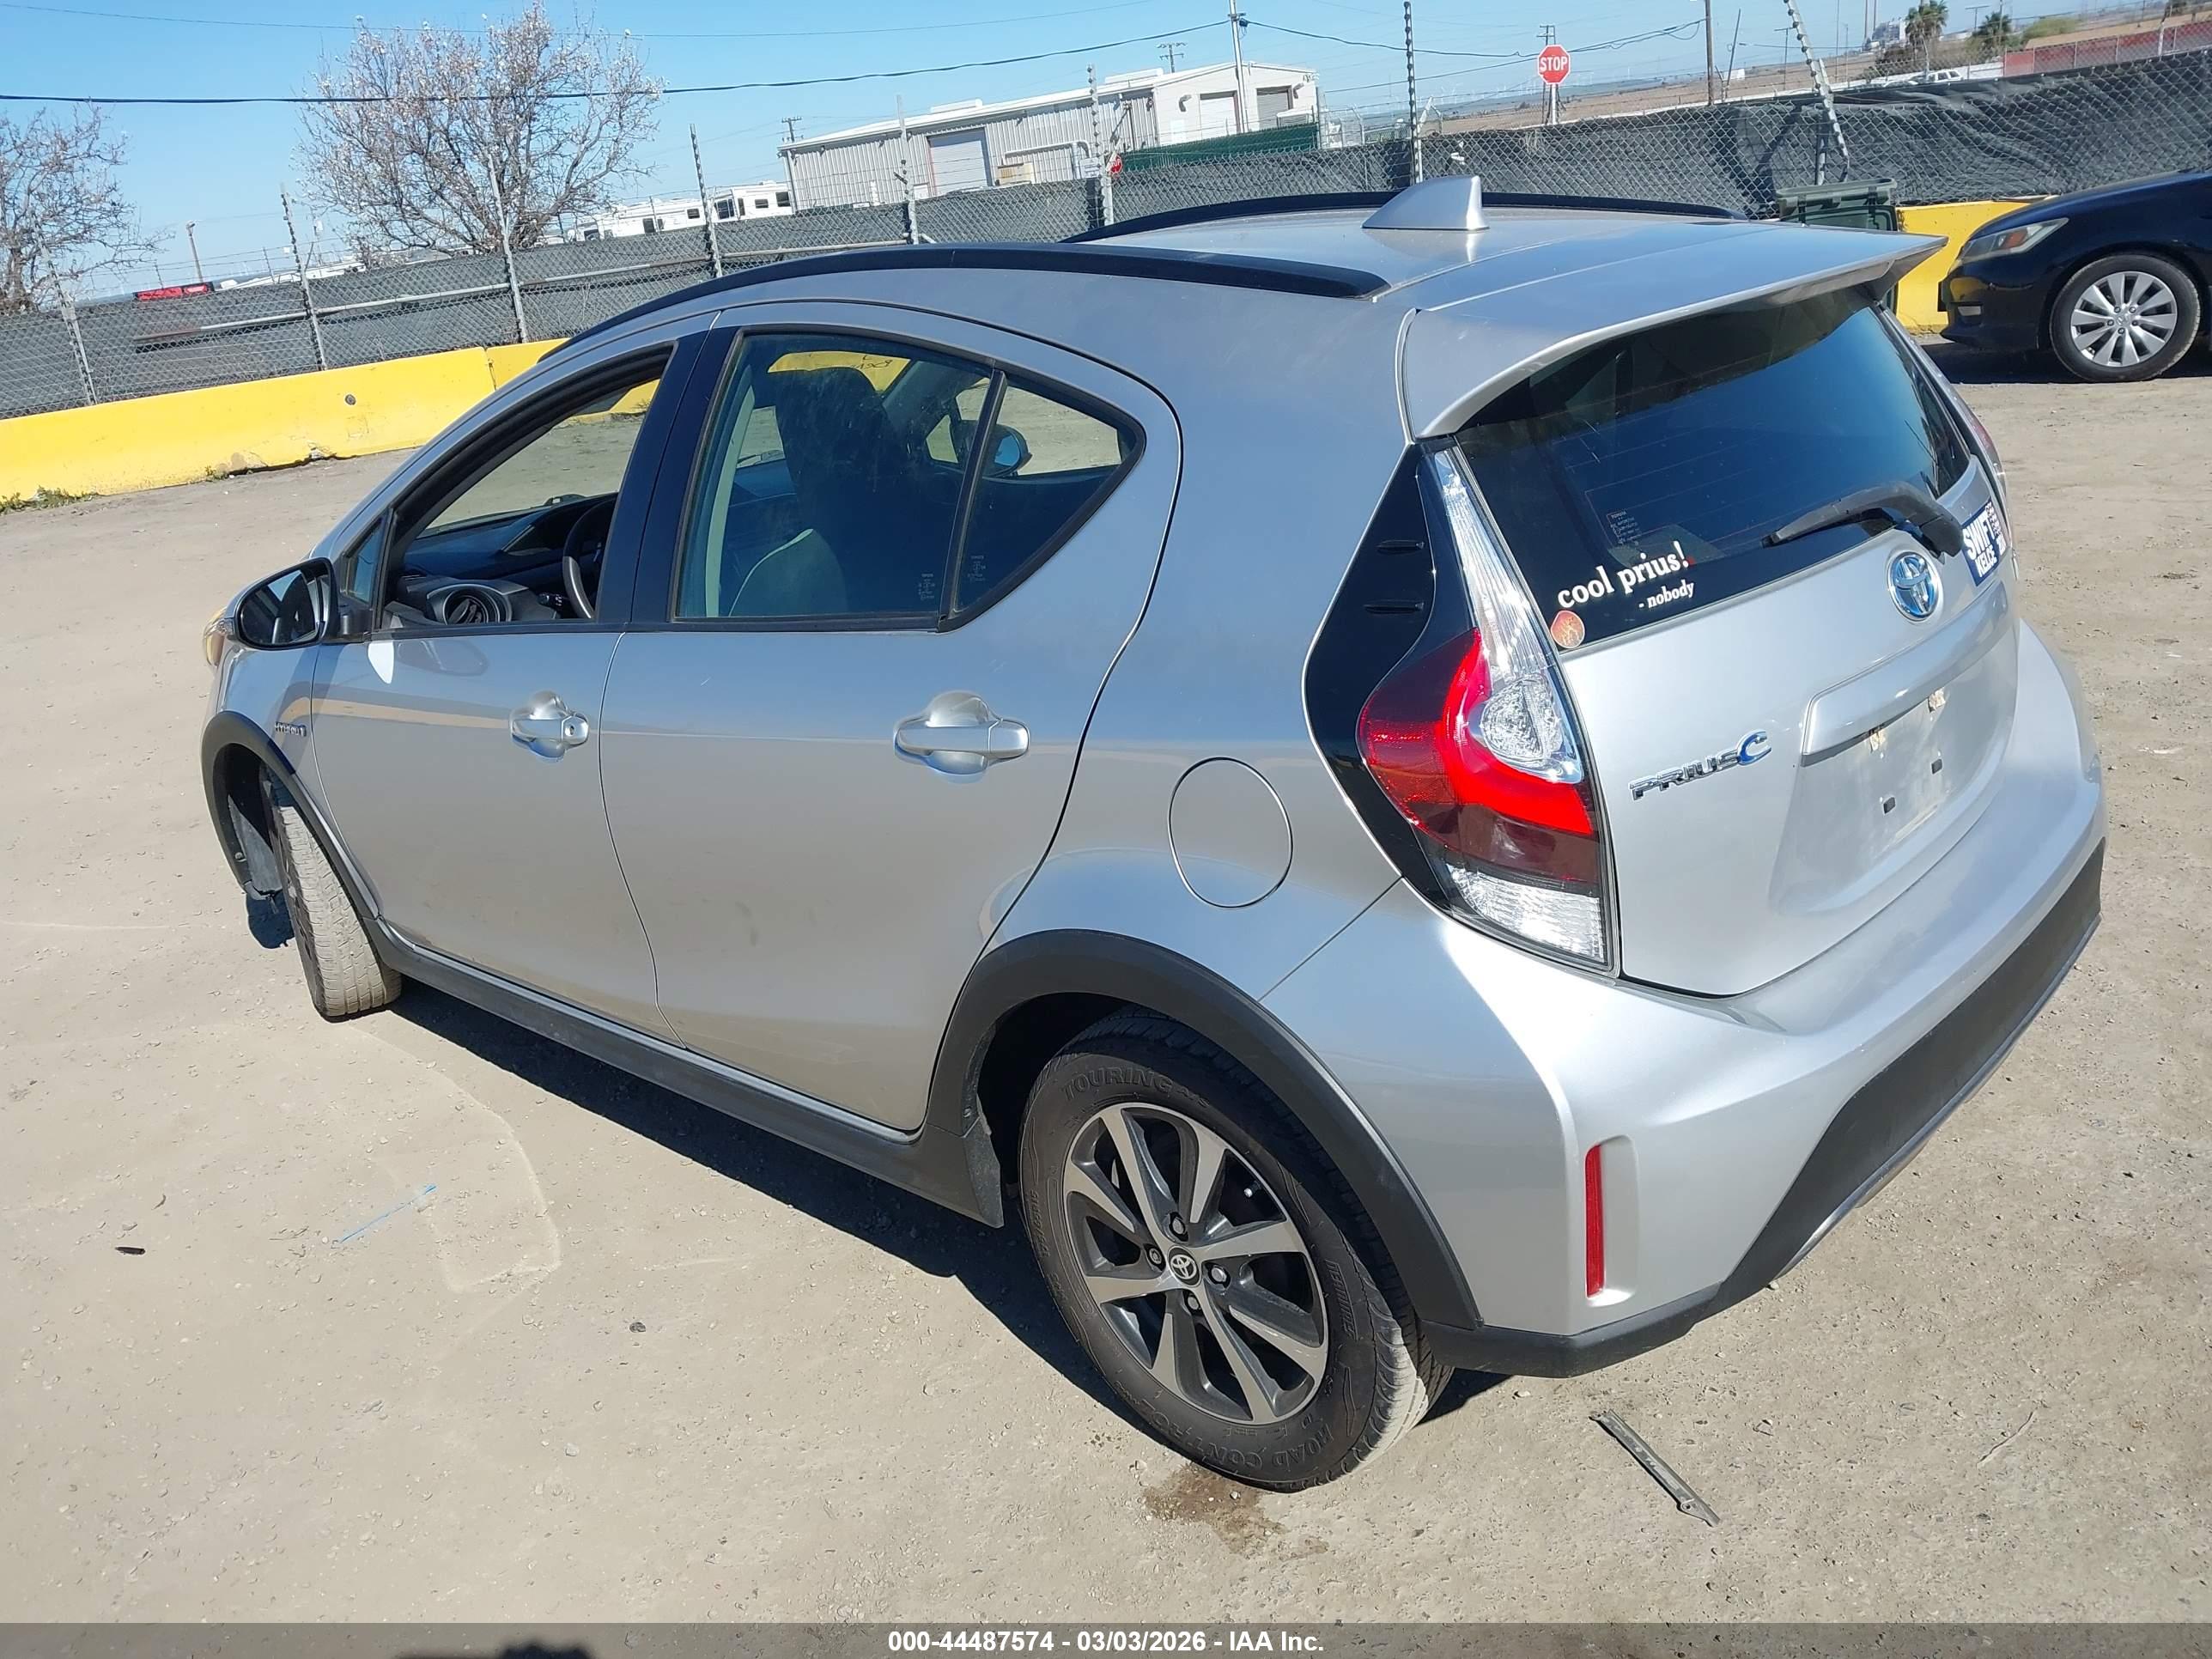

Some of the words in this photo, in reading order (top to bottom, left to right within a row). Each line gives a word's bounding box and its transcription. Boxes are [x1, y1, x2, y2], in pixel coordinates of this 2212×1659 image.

[1540, 56, 1568, 72] STOP
[1962, 509, 1996, 561] SWIFT
[1558, 564, 1615, 608] cool
[1617, 540, 1690, 595] prius!
[1975, 544, 1997, 578] KELCE
[1646, 579, 1695, 609] nobody
[1060, 1066, 1174, 1103] TOURING
